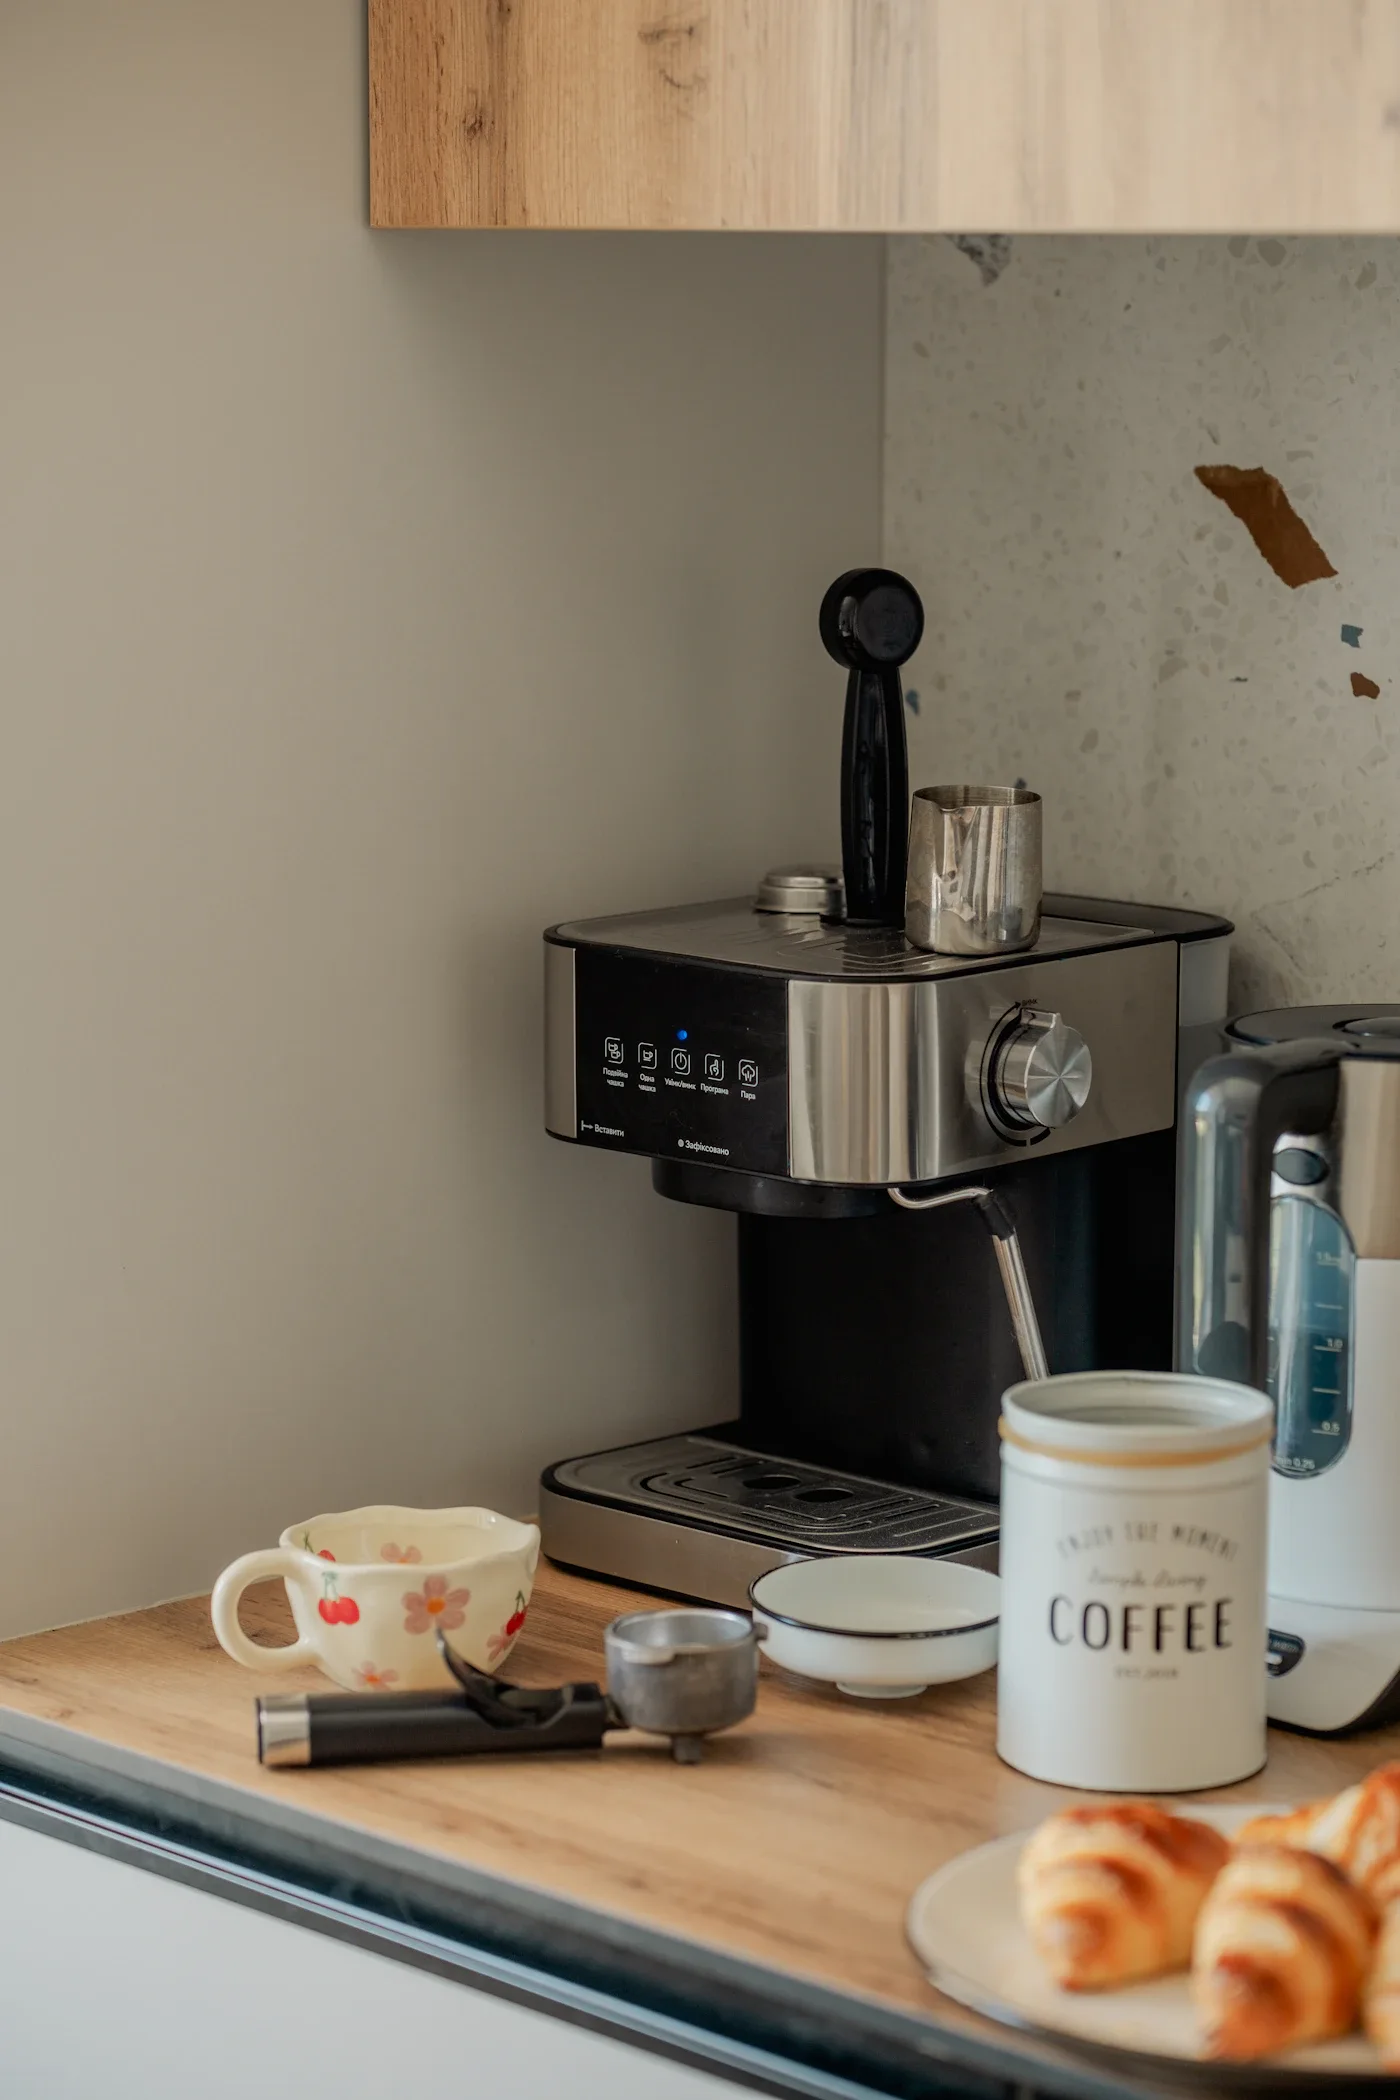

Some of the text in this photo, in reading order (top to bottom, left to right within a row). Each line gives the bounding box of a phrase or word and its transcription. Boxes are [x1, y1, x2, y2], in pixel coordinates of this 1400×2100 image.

[639, 1073, 655, 1083] Одна
[700, 1083, 729, 1095] Програма
[740, 1090, 756, 1101] Пара
[594, 1123, 625, 1138] Вставити
[684, 1139, 730, 1156] Зафіксовано
[1124, 1520, 1159, 1543] THE
[1048, 1593, 1235, 1654] COFFEE
